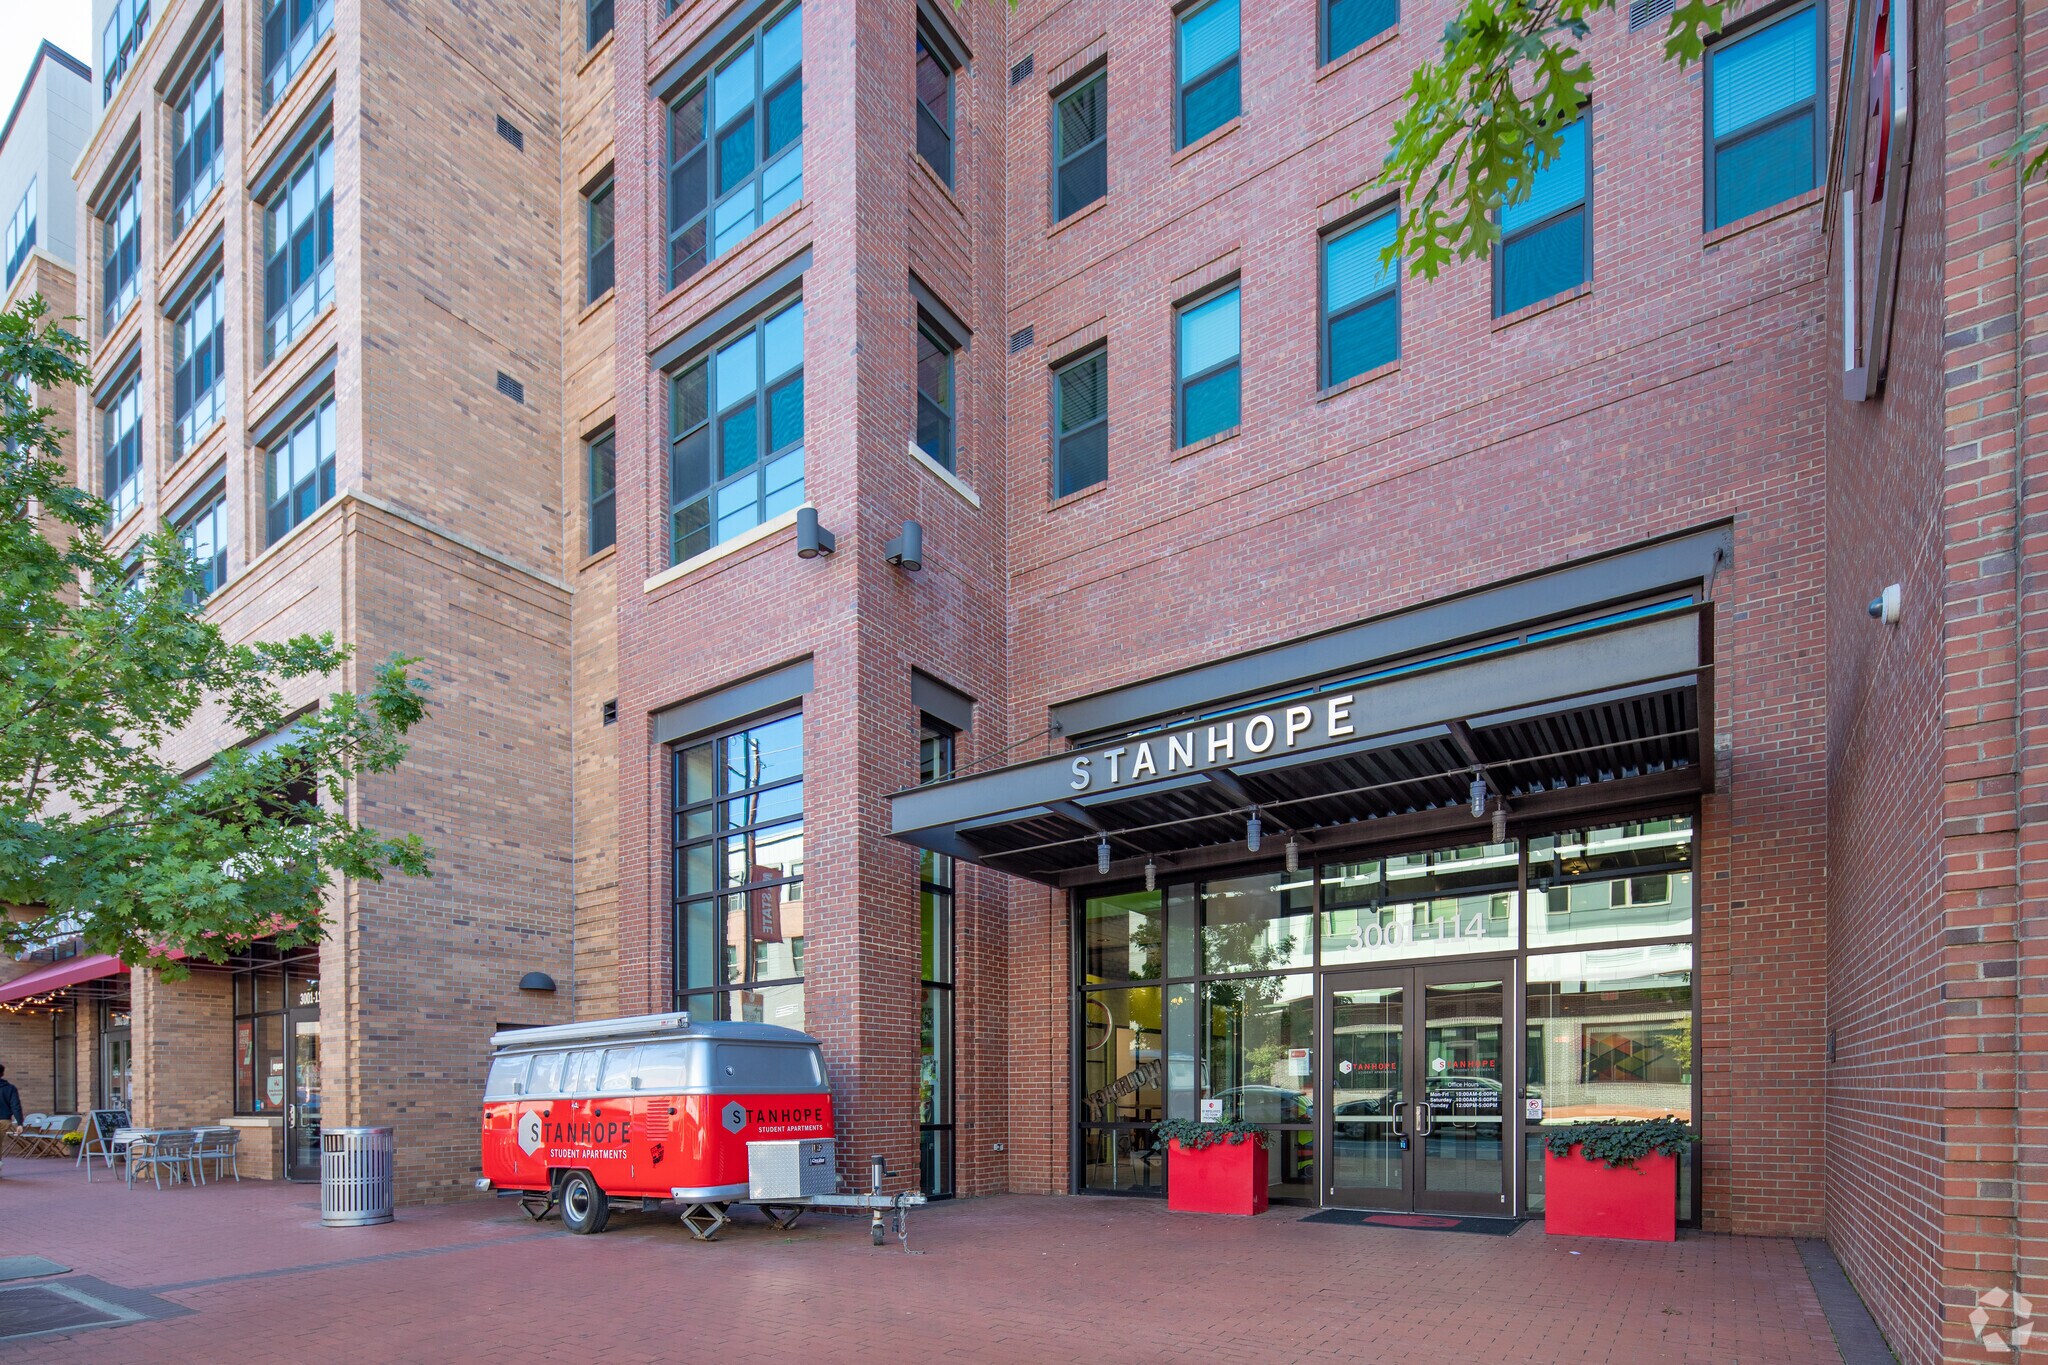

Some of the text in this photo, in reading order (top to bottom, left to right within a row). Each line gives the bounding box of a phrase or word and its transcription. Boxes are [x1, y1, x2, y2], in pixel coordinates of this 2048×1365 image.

[1070, 694, 1355, 790] STANHOPE
[1345, 912, 1487, 951] 3001-114
[1346, 1062, 1397, 1071] STANHOPE
[1439, 1059, 1496, 1069] STANHOPE
[732, 1108, 823, 1124] STANHOPE
[531, 1122, 631, 1143] STANHOPE
[787, 1124, 823, 1132] APARTMENTS
[550, 1148, 627, 1159] STUDENT APARTMENTS
